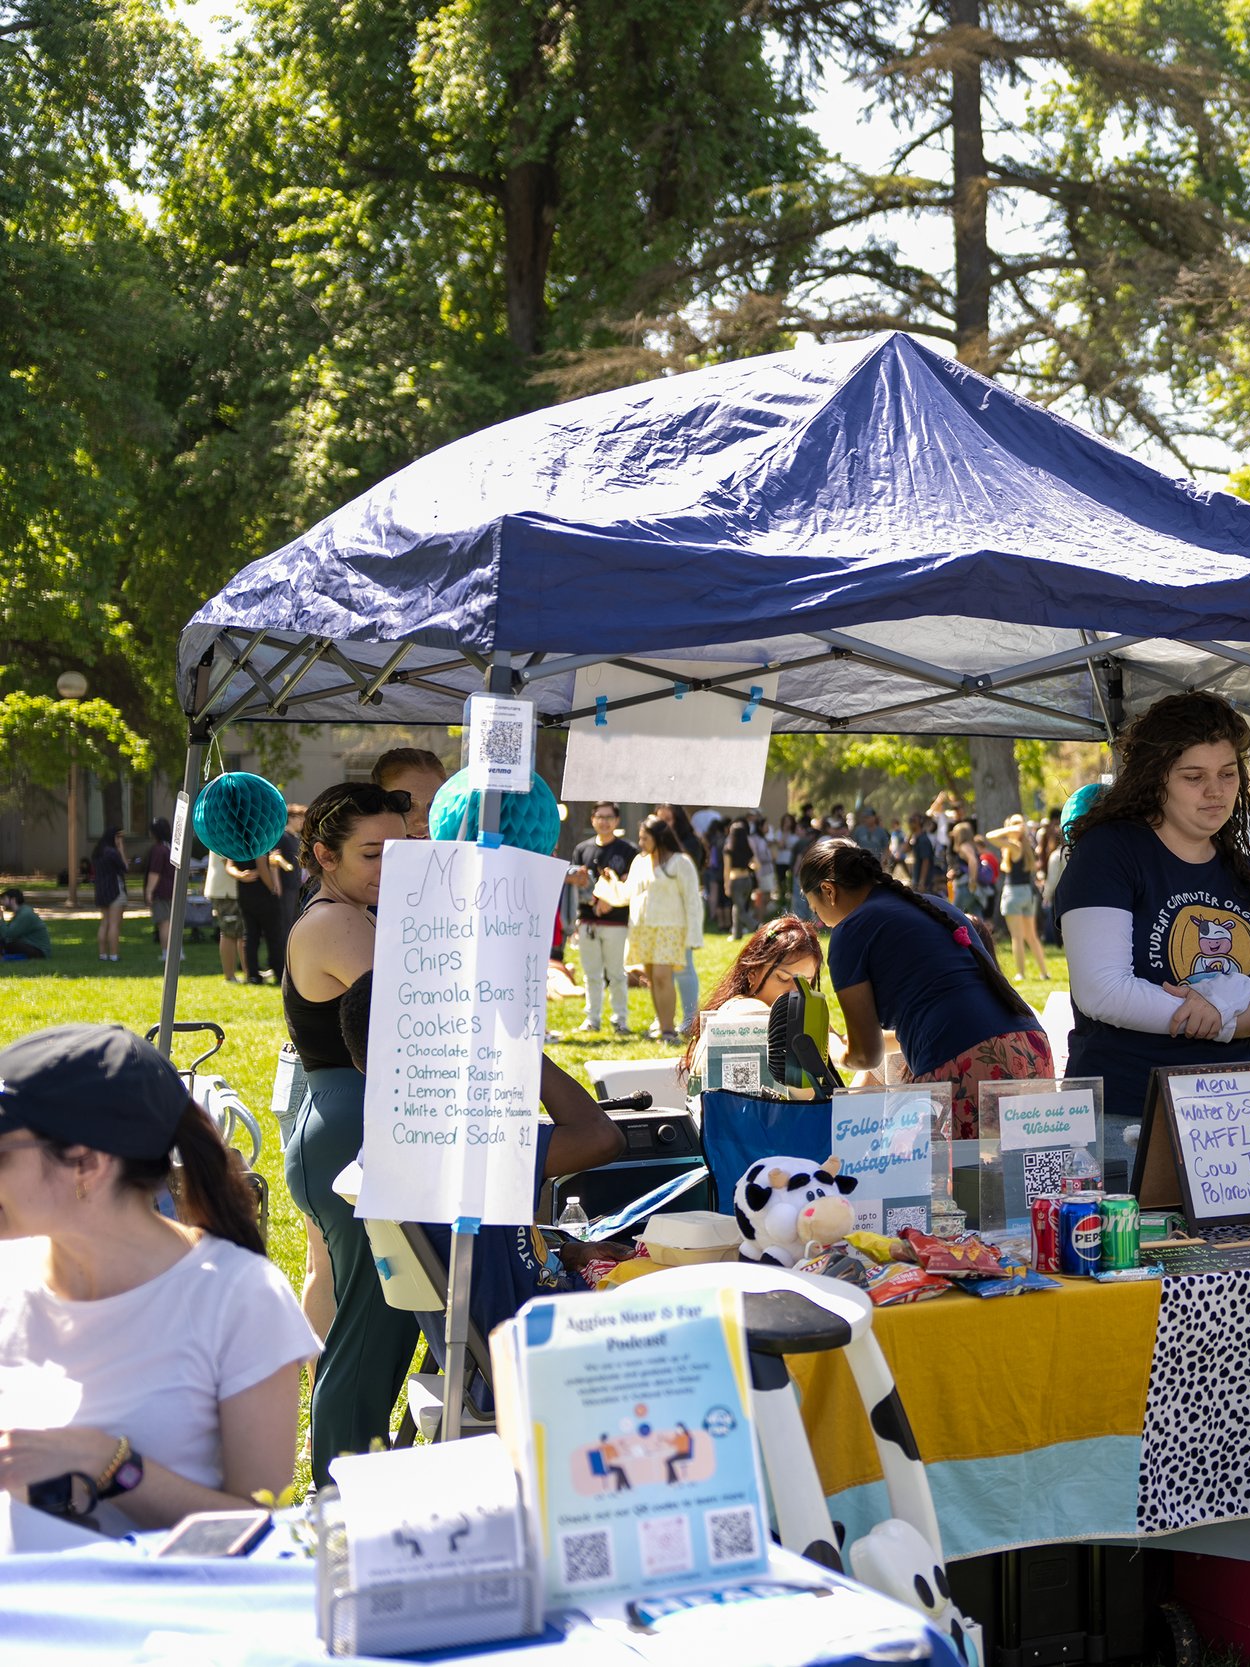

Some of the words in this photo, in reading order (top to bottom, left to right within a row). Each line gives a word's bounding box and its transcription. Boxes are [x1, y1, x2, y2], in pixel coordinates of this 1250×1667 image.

[406, 848, 530, 914] Menu
[401, 916, 474, 944] Bottled
[484, 915, 524, 937] Water
[528, 913, 541, 938] $1
[1148, 908, 1171, 969] STUDENT
[1166, 890, 1220, 910] COMMUTER
[404, 946, 463, 976] Chips
[525, 953, 541, 983] $1
[398, 982, 471, 1006] Granola
[475, 980, 515, 1003] Bars
[525, 985, 541, 1008] $1
[397, 1013, 482, 1040] Cookies
[523, 1013, 541, 1041] $2
[752, 1026, 768, 1035] Cod
[406, 1044, 469, 1058] Chocolate
[477, 1046, 503, 1064] Chip
[406, 1064, 461, 1080] Oatmeal
[466, 1064, 504, 1082] Raisin
[407, 1082, 457, 1099] Lemon
[403, 1102, 438, 1118] White
[444, 1104, 503, 1118] Chocolate
[1004, 1107, 1041, 1121] Check
[1045, 1105, 1065, 1117] out
[1069, 1104, 1090, 1115] our
[1181, 1103, 1223, 1121] Water
[1226, 1104, 1242, 1121] &
[392, 1122, 458, 1146] Canned
[466, 1124, 506, 1146] Soda
[518, 1125, 532, 1147] $1
[836, 1117, 896, 1141] Follow
[901, 1111, 919, 1127] us
[1022, 1120, 1071, 1135] Website
[870, 1136, 892, 1152] on
[839, 1140, 930, 1176] Instagram!
[1193, 1156, 1238, 1178] Cow
[858, 1213, 868, 1222] up
[869, 1212, 877, 1220] to
[516, 1226, 535, 1270] STUD
[605, 1332, 668, 1352] Podcast
